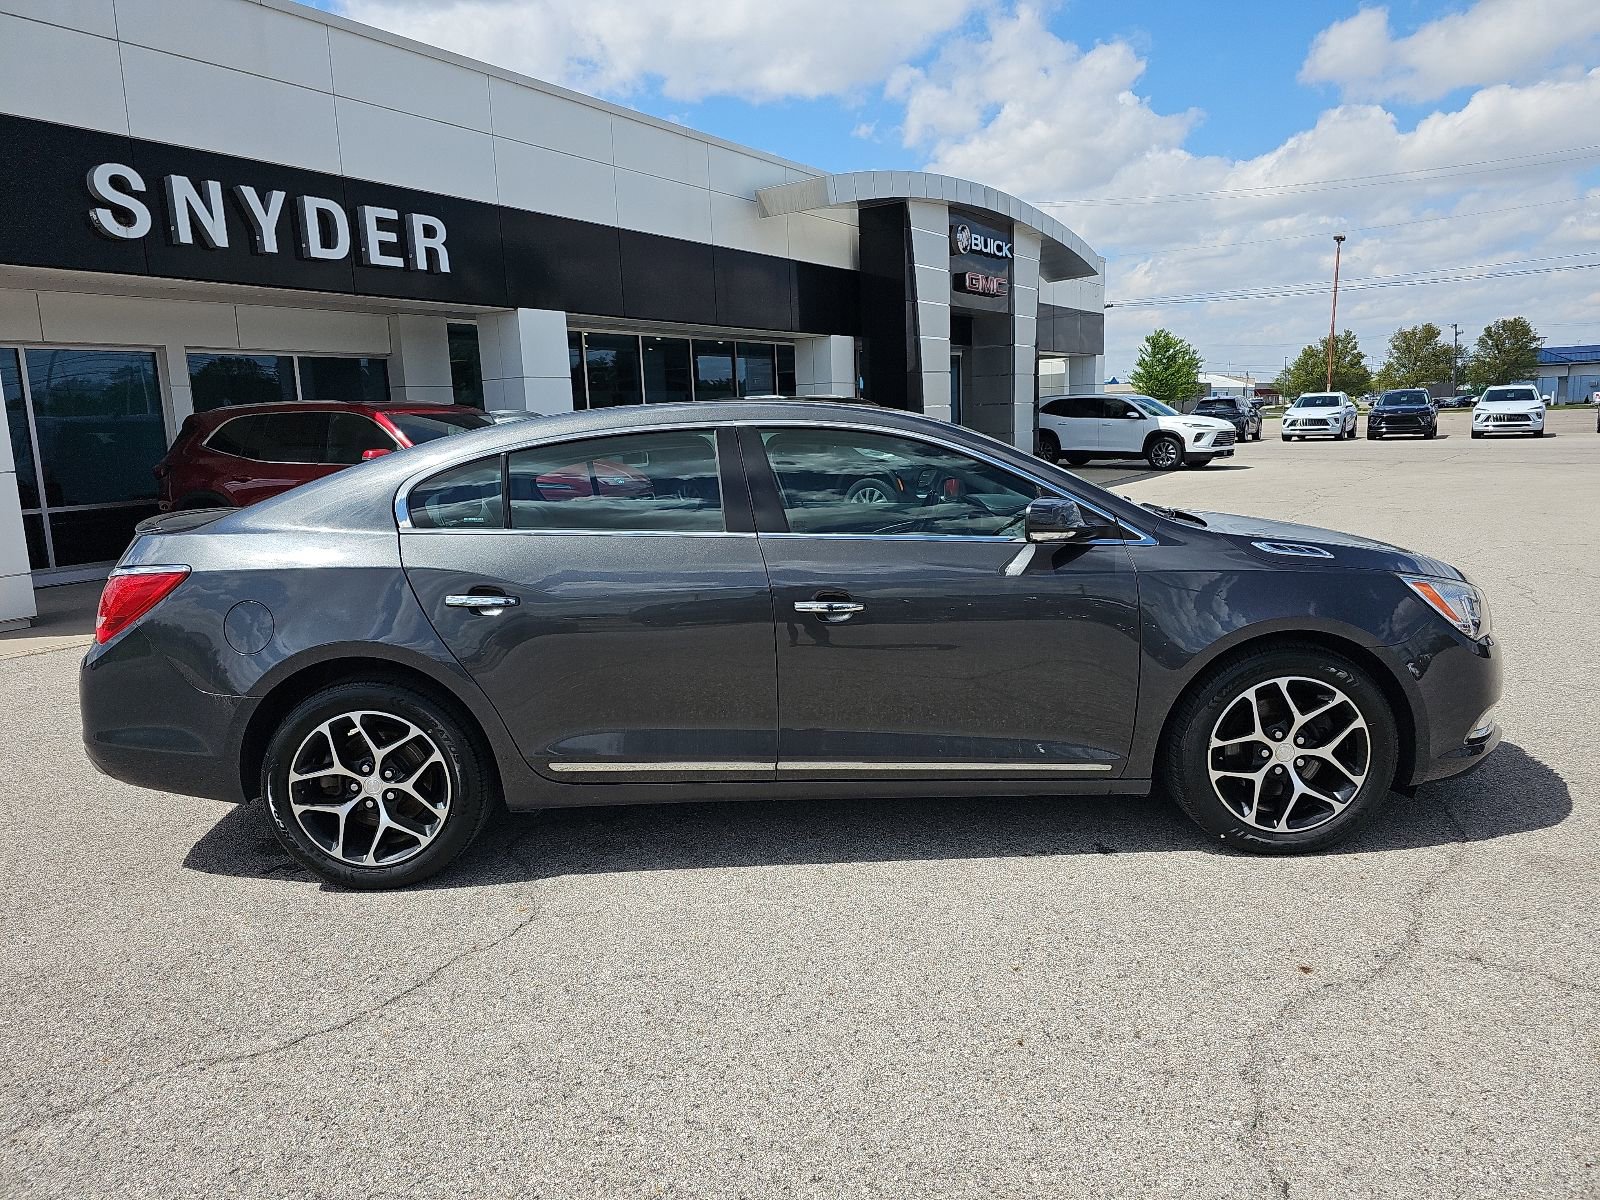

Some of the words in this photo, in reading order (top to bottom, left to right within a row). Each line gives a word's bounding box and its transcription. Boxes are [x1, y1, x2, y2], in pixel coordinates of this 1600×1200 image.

[87, 162, 451, 273] SNYDER
[971, 233, 1013, 258] BUICK
[966, 272, 1008, 295] GMC
